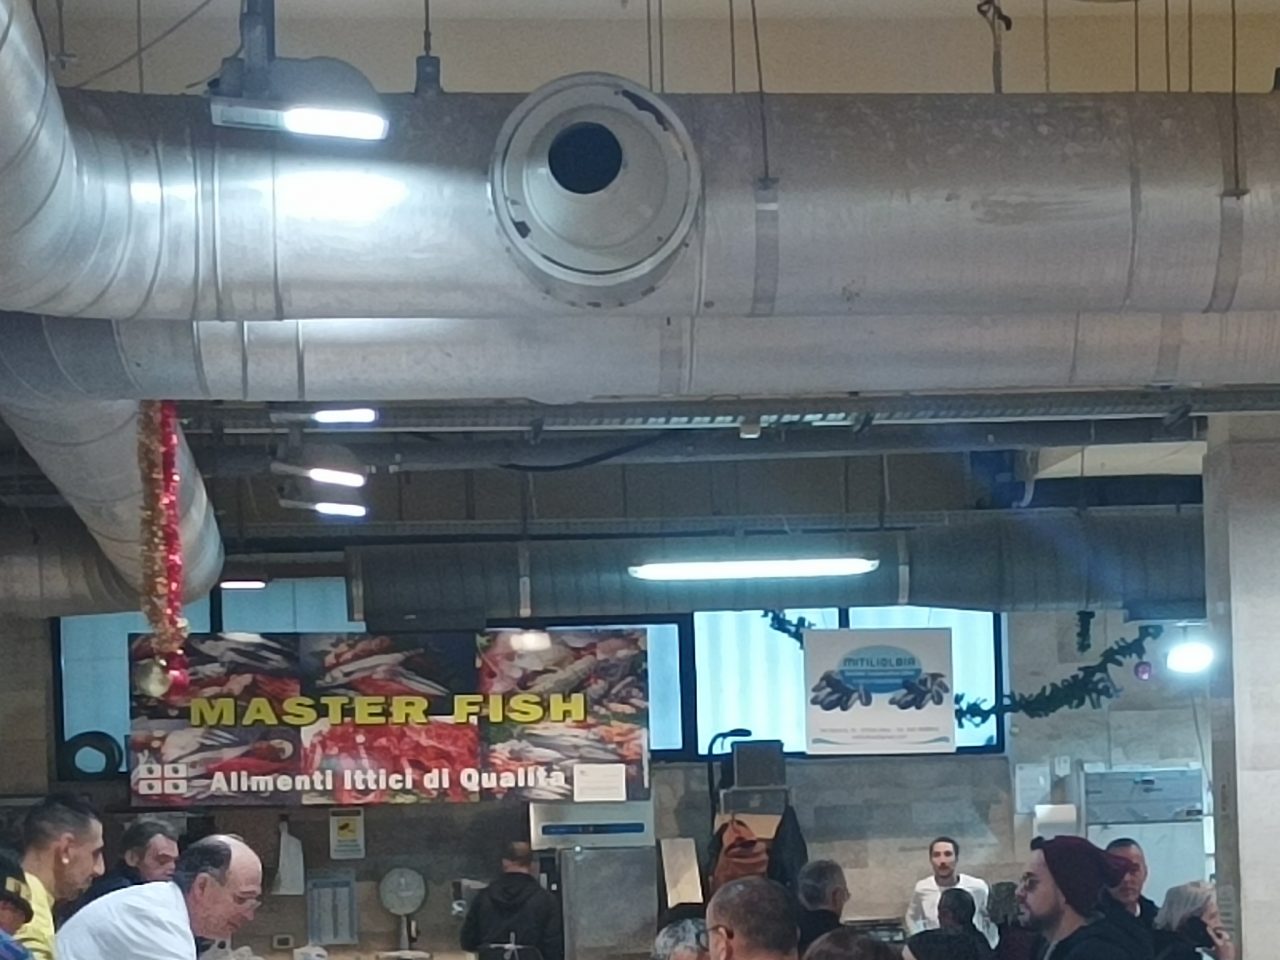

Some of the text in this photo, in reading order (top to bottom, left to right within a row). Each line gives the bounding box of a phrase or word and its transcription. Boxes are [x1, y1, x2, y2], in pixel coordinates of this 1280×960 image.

[190, 693, 585, 727] MASTER FISH
[210, 769, 333, 793] Alimenti
[343, 768, 413, 791] Ittici
[423, 767, 450, 790] di
